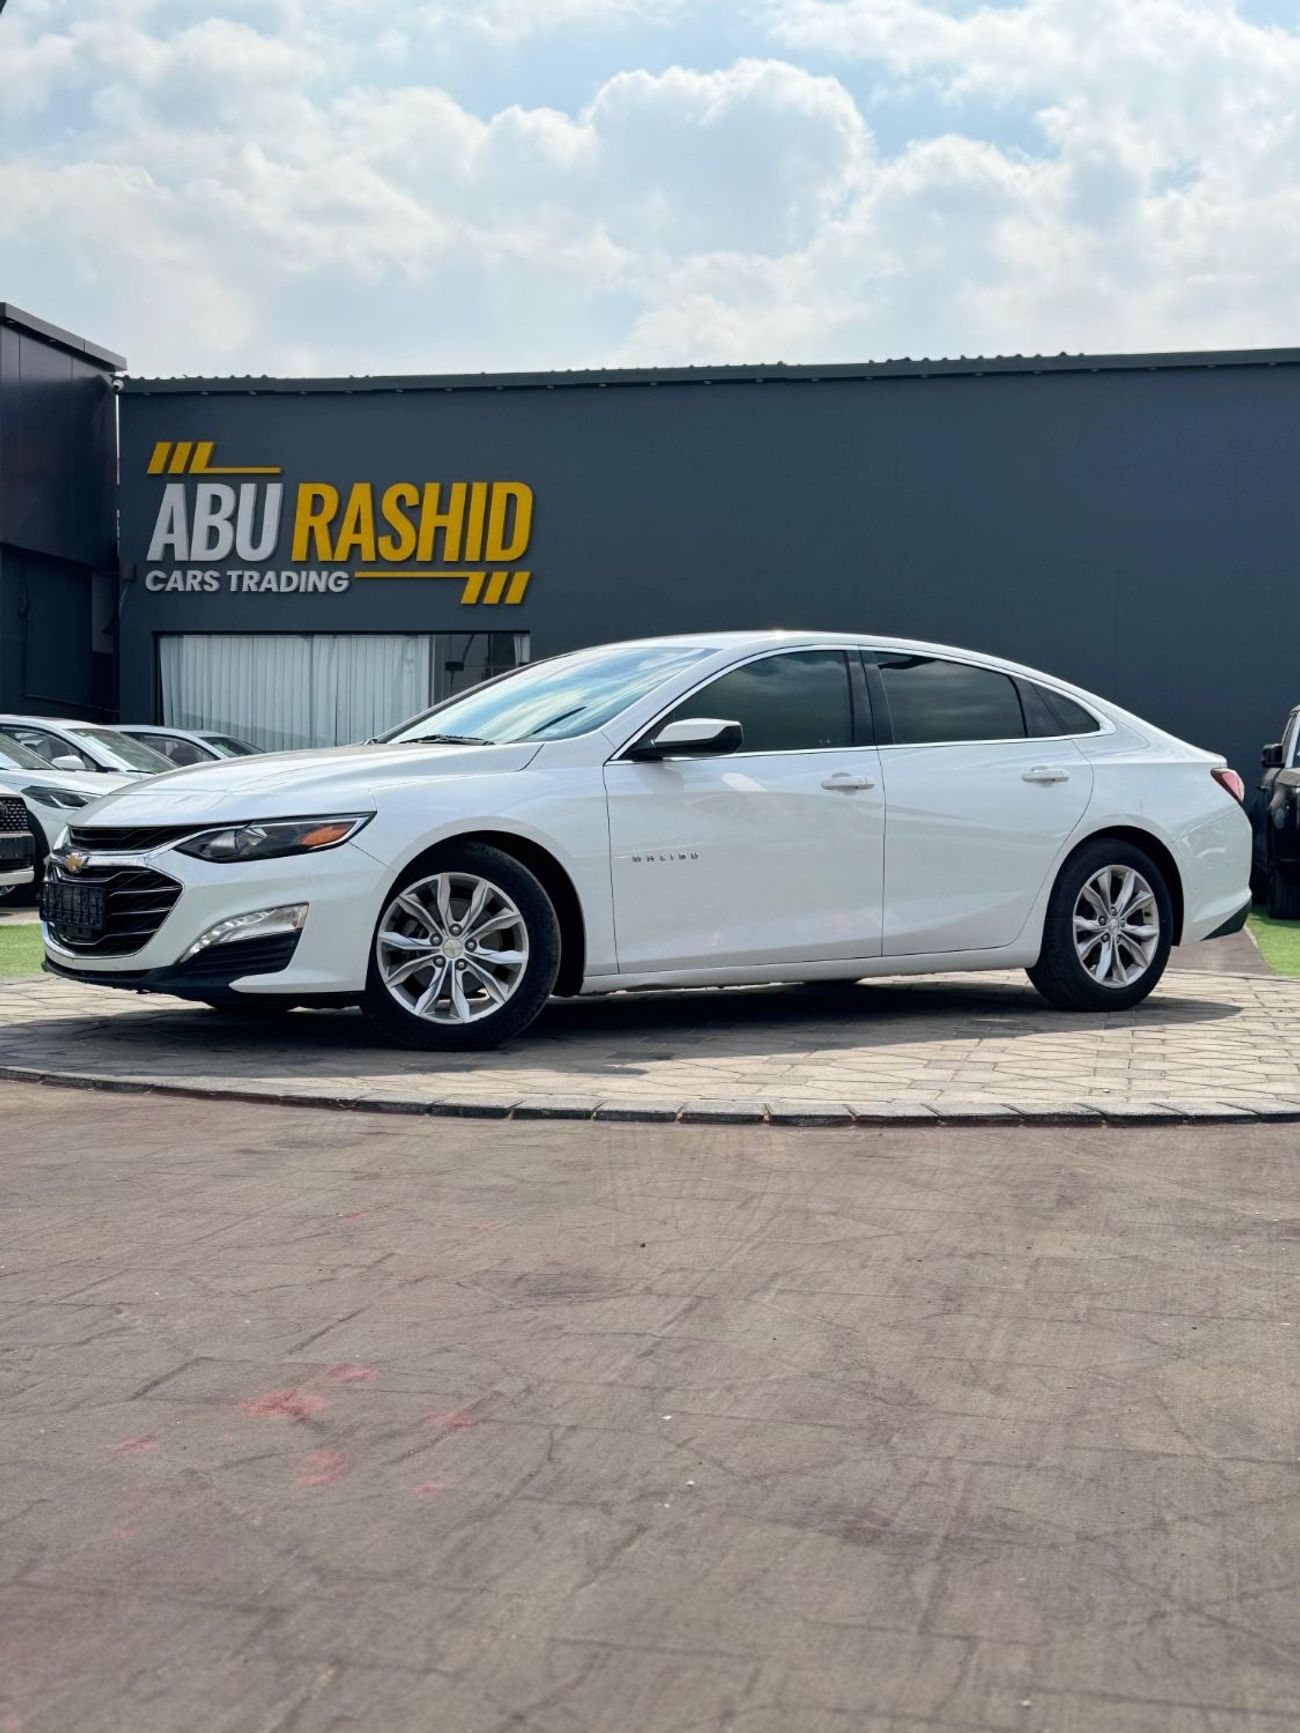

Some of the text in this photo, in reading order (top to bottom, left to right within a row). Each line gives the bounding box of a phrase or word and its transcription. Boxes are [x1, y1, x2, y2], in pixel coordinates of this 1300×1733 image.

[146, 481, 534, 562] ABU RASHID
[145, 570, 350, 593] CARS TRADING
